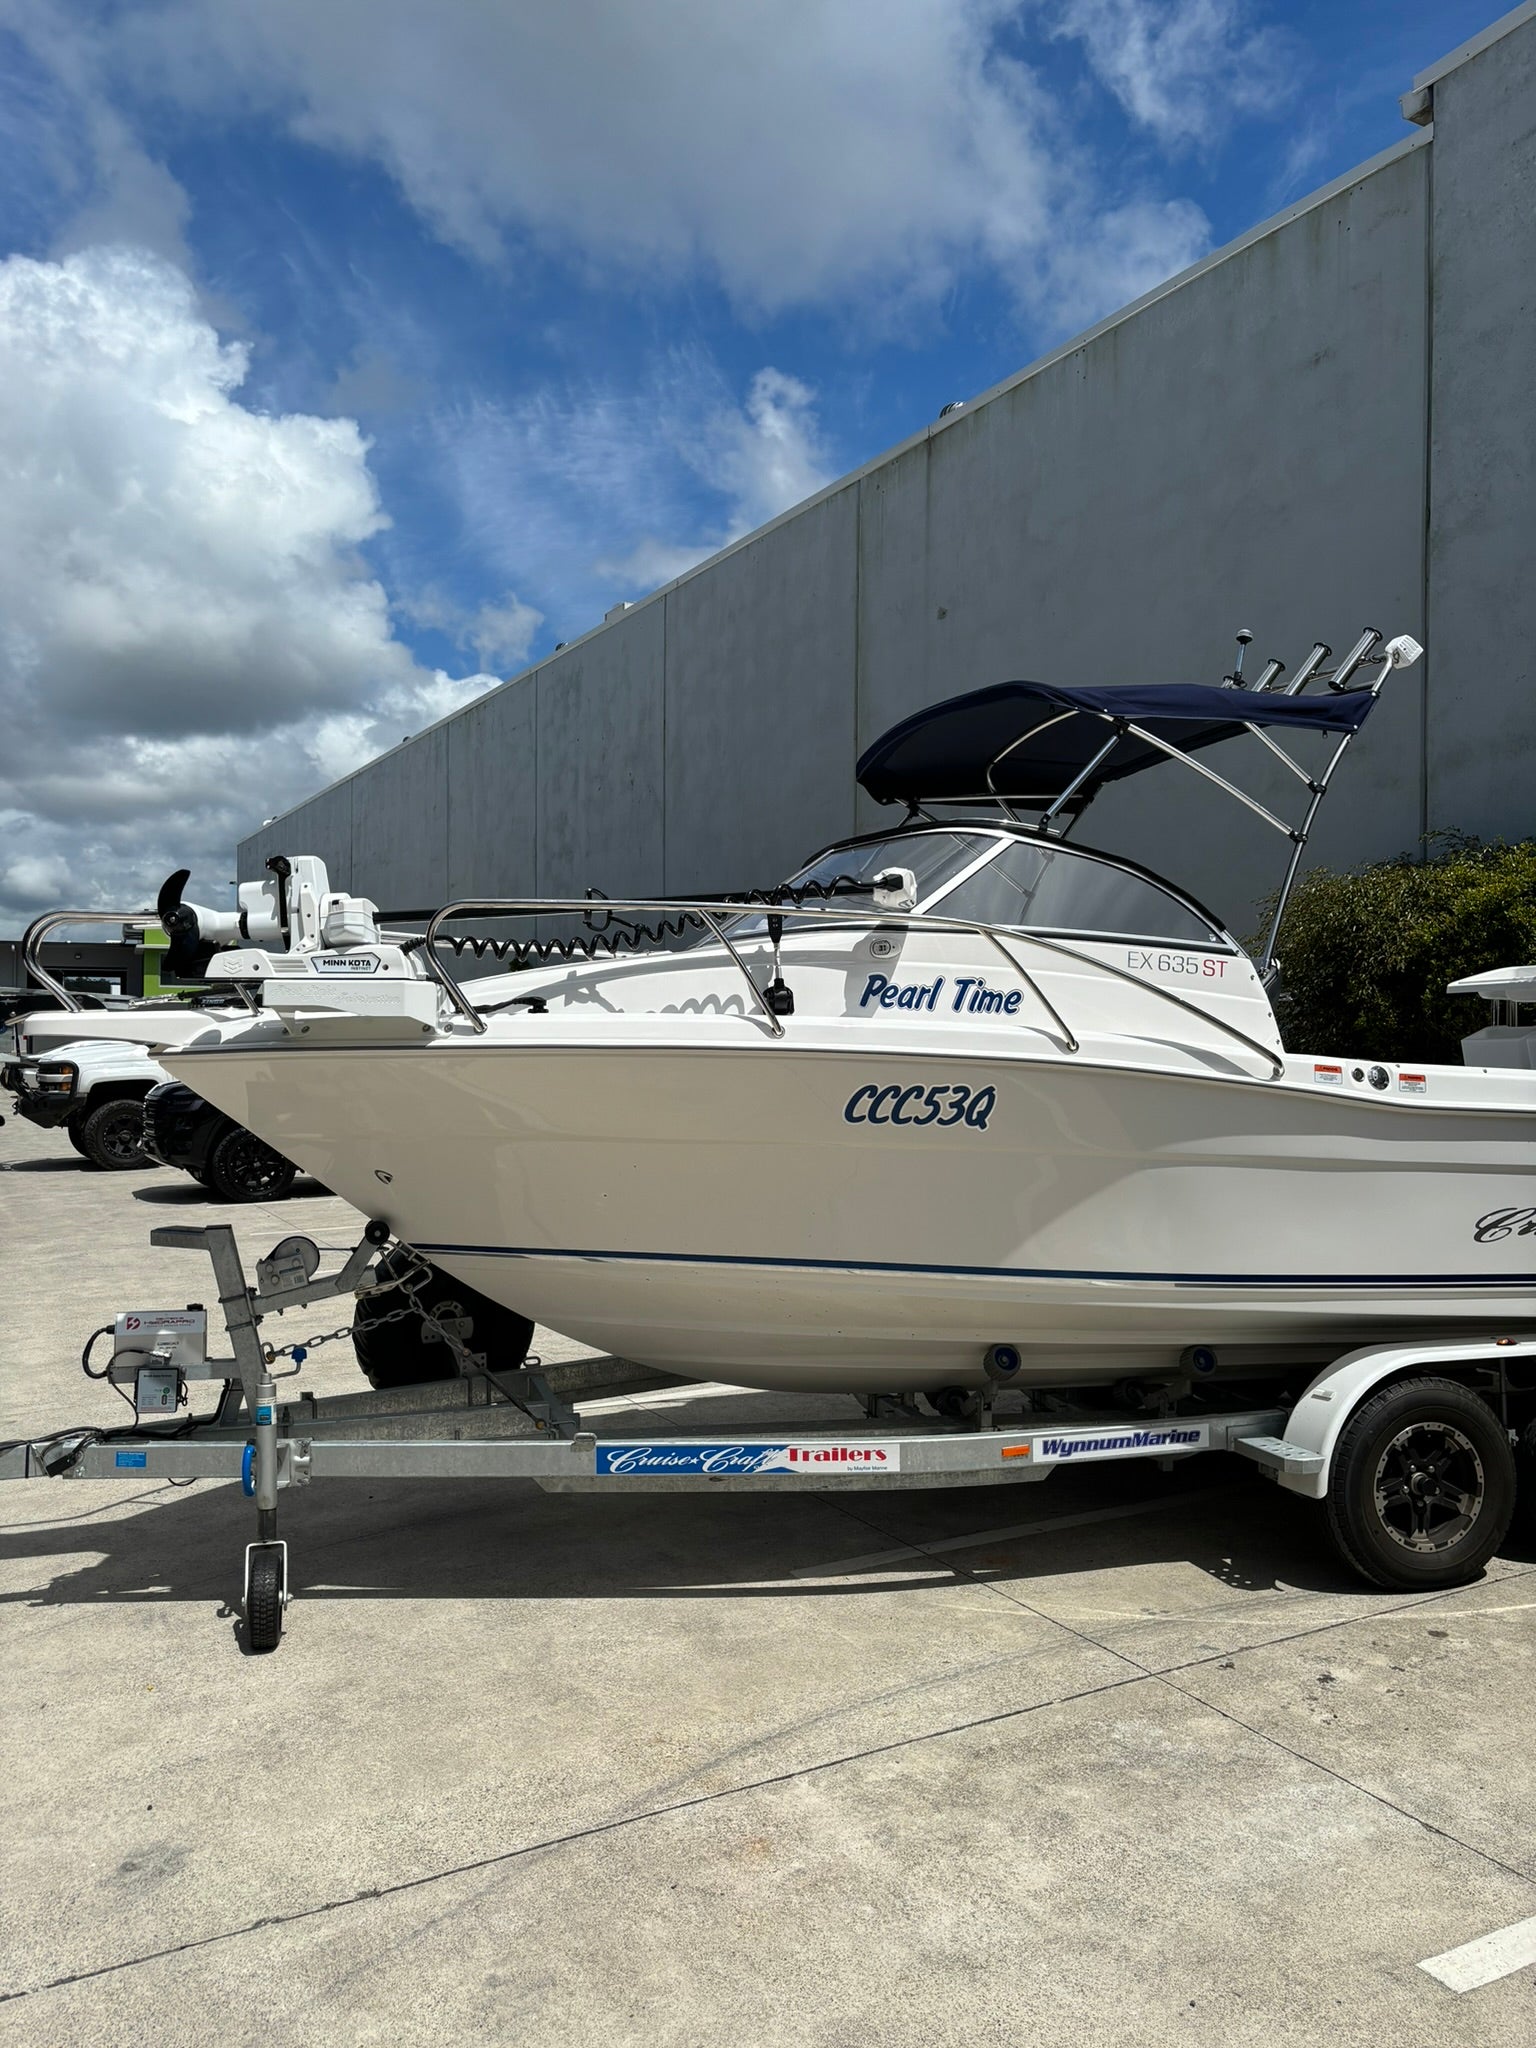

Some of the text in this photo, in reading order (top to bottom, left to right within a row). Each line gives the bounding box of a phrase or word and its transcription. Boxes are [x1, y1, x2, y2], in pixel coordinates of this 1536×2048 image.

[322, 959, 372, 967] MINN KOTA
[1127, 951, 1228, 978] EX 635 ST
[859, 973, 1023, 1014] Pearl Time
[844, 1083, 997, 1131] CCC53Q
[787, 1447, 888, 1462] Trailers
[1042, 1429, 1201, 1457] WynnumMarine
